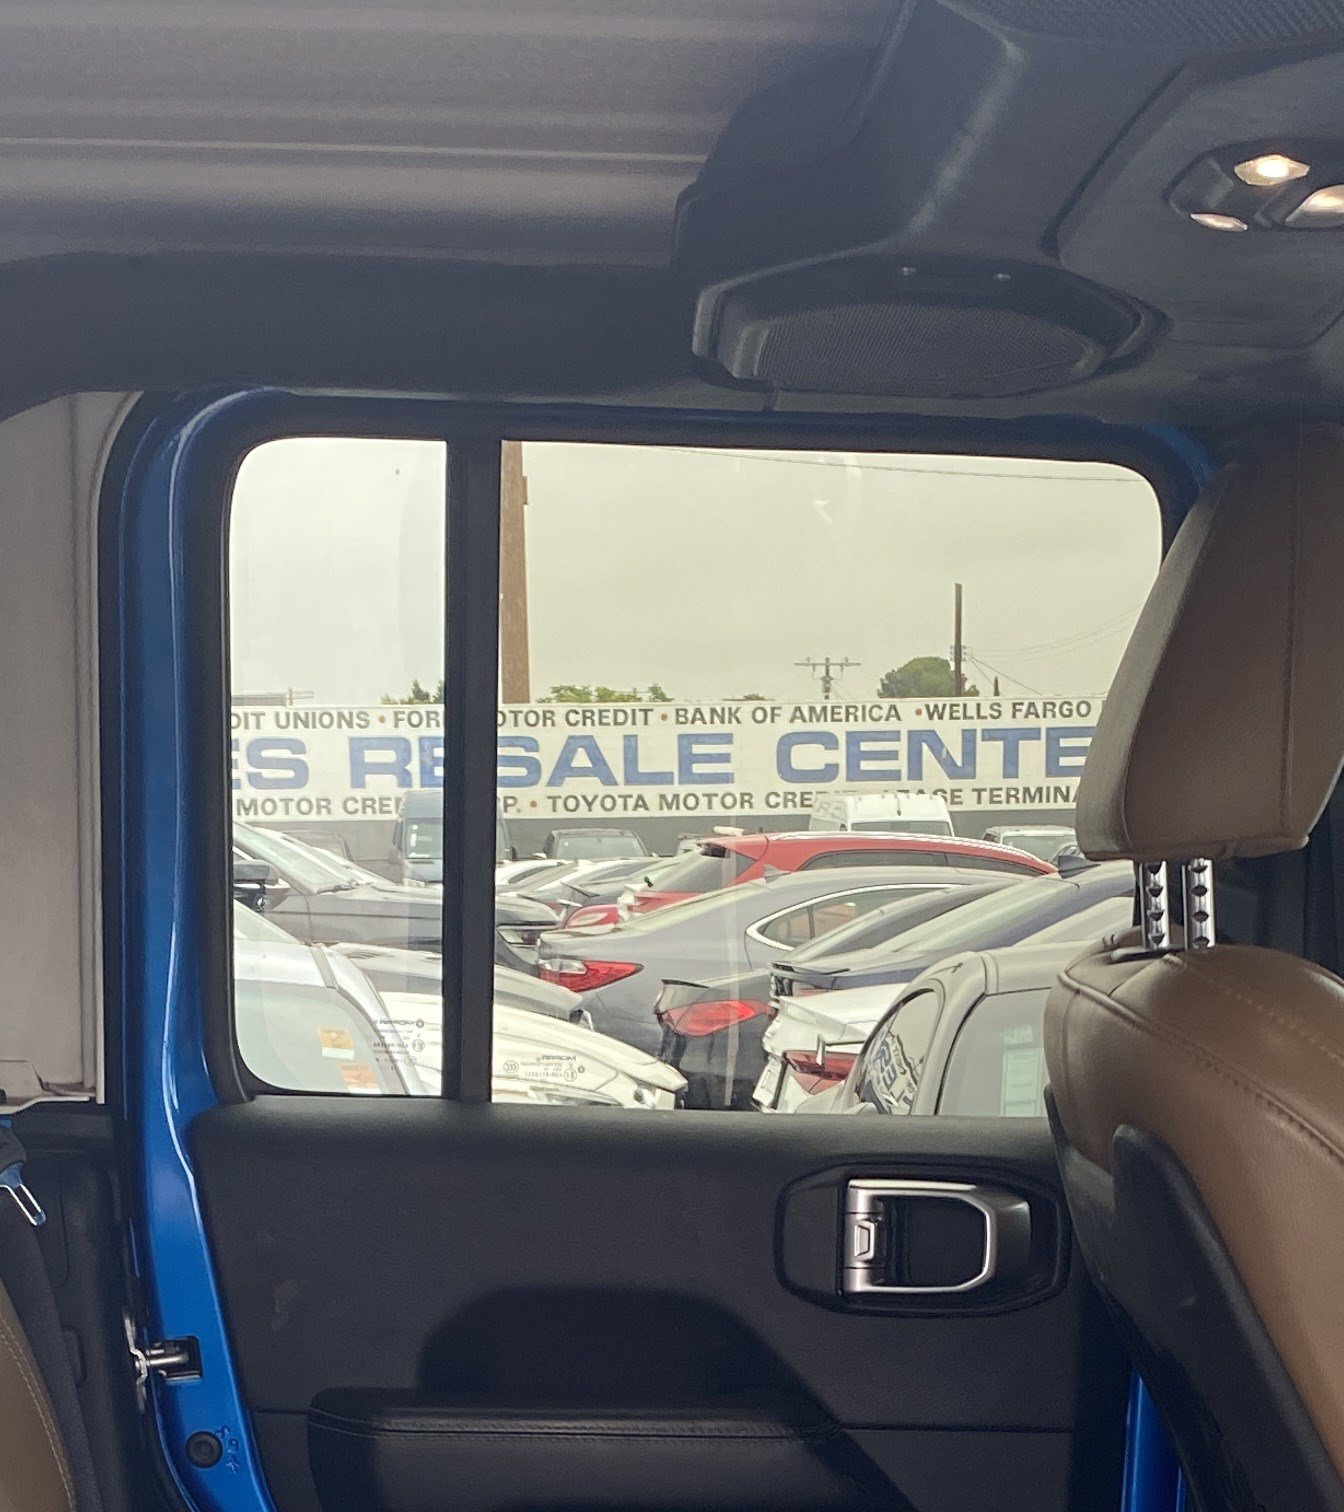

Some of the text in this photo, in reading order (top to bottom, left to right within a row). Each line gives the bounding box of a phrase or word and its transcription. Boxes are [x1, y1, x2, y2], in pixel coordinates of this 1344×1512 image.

[274, 710, 371, 730] UNIONS
[393, 710, 443, 729] FOR
[565, 708, 654, 727] CREDIT
[674, 706, 742, 725] BANK
[751, 706, 783, 724] OF
[789, 704, 902, 723] AMERICA
[923, 702, 1003, 721] WELLS
[1011, 700, 1092, 719] FARGO
[236, 797, 332, 816] MOTOR
[342, 796, 403, 815] CRE
[547, 793, 650, 813] TOYOTA
[658, 792, 754, 811] MOTOR
